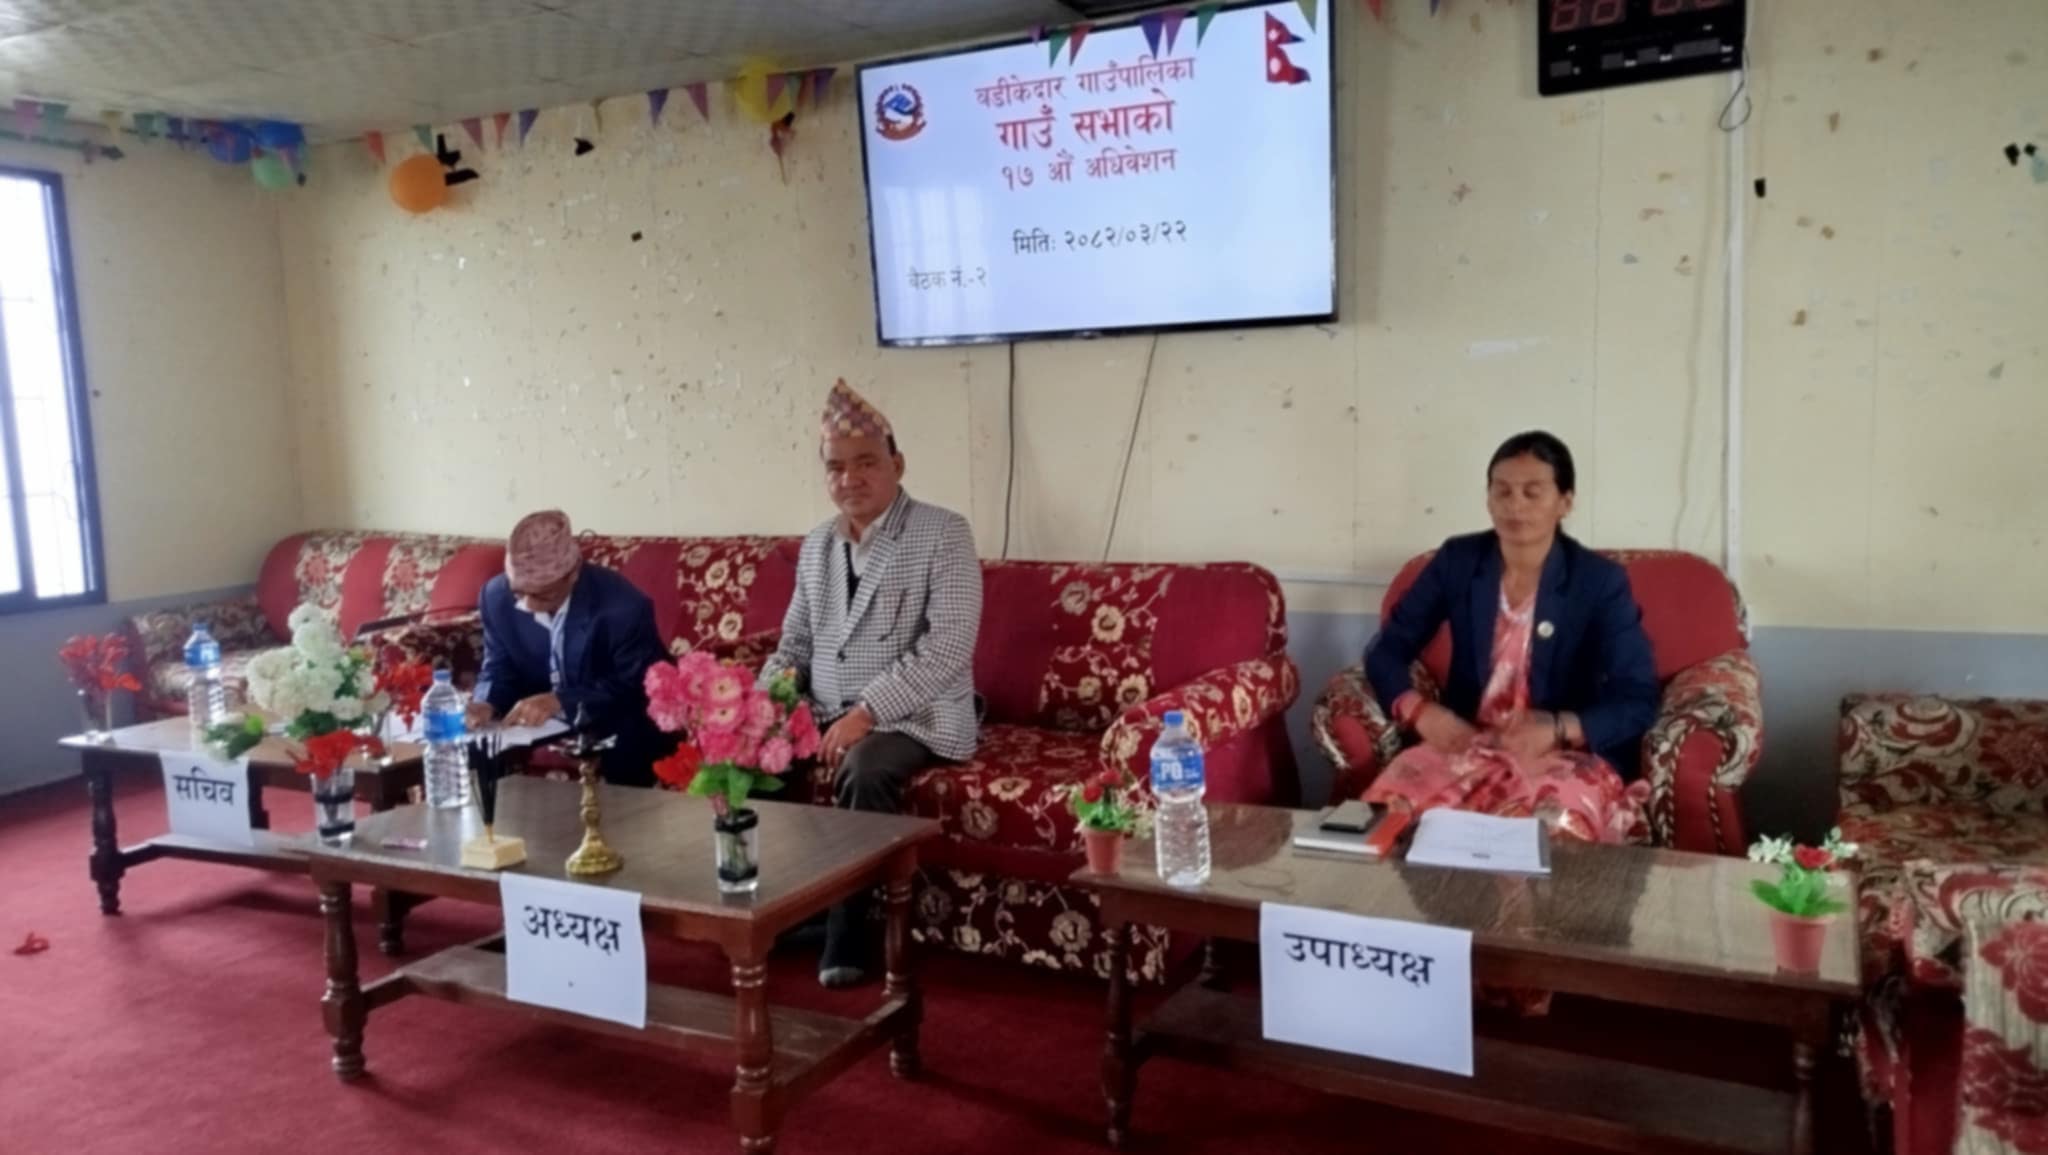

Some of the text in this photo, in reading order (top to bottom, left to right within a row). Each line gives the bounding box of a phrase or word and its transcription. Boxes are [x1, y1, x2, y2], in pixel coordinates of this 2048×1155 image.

[995, 87, 1175, 150] गाउँ सभाको
[1002, 164, 1035, 191] १७
[1085, 145, 1178, 178] अधिवेशन
[1064, 219, 1188, 252] २०८२/०३/२२
[172, 766, 236, 806] सचिव
[522, 905, 622, 956] अध्यक्ष
[1283, 932, 1435, 988] उपाध्यक्ष
